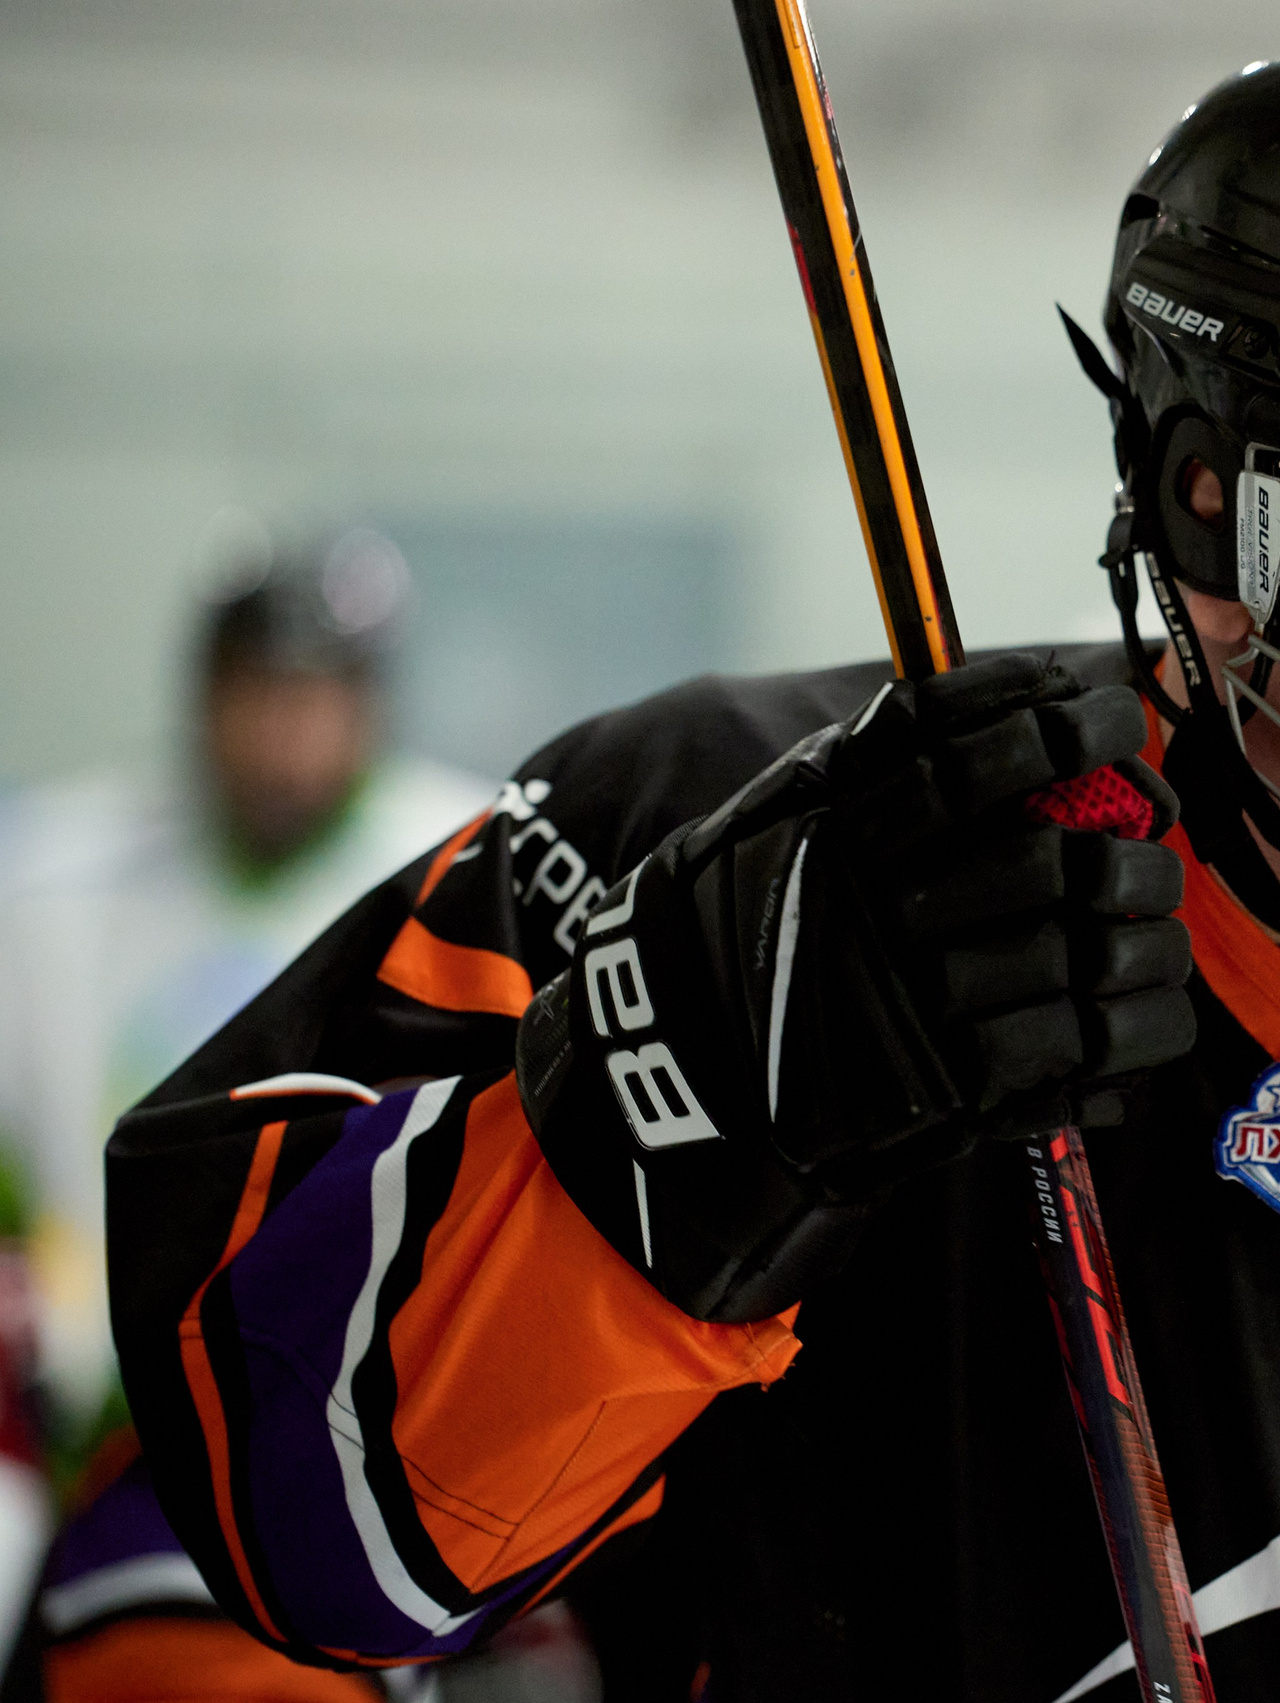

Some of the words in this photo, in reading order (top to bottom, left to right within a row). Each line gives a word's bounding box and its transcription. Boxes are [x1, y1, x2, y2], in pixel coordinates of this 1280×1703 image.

[1126, 283, 1225, 342] BAUER
[1259, 486, 1270, 594] BAUER
[1026, 1146, 1043, 1159] В
[1031, 1165, 1063, 1244] РОССИИ
